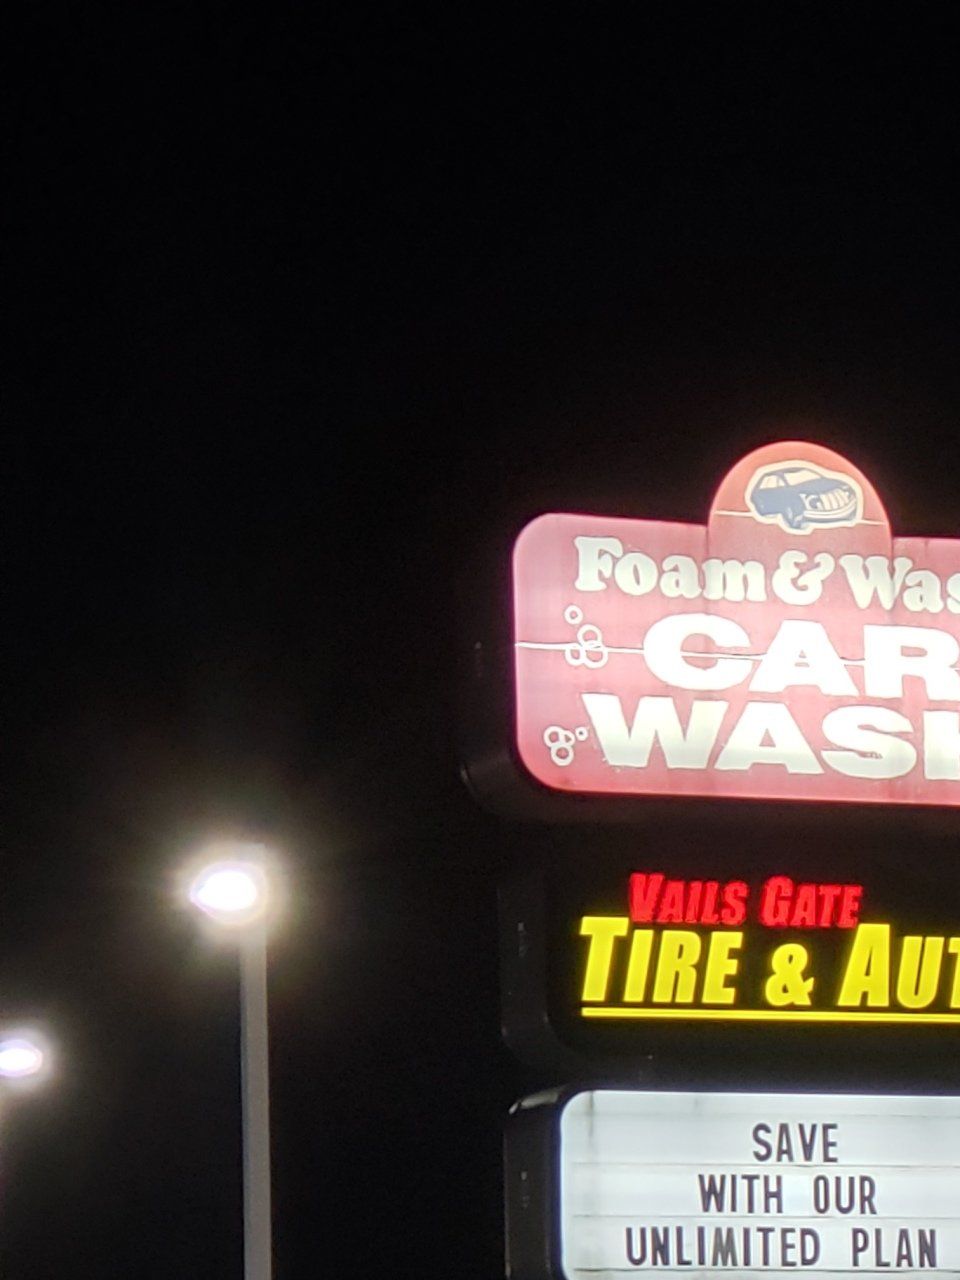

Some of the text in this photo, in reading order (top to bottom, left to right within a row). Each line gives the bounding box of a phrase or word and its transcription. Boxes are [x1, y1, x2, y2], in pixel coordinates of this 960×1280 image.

[574, 536, 767, 601] Foam
[772, 550, 834, 606] &
[760, 876, 863, 928] GATE
[580, 916, 743, 1004] TIRE
[765, 943, 814, 1006] &
[752, 1123, 838, 1163] SAVE
[699, 1174, 877, 1215] WITH OUR
[625, 1226, 938, 1268] UNLIMITED PLAN
